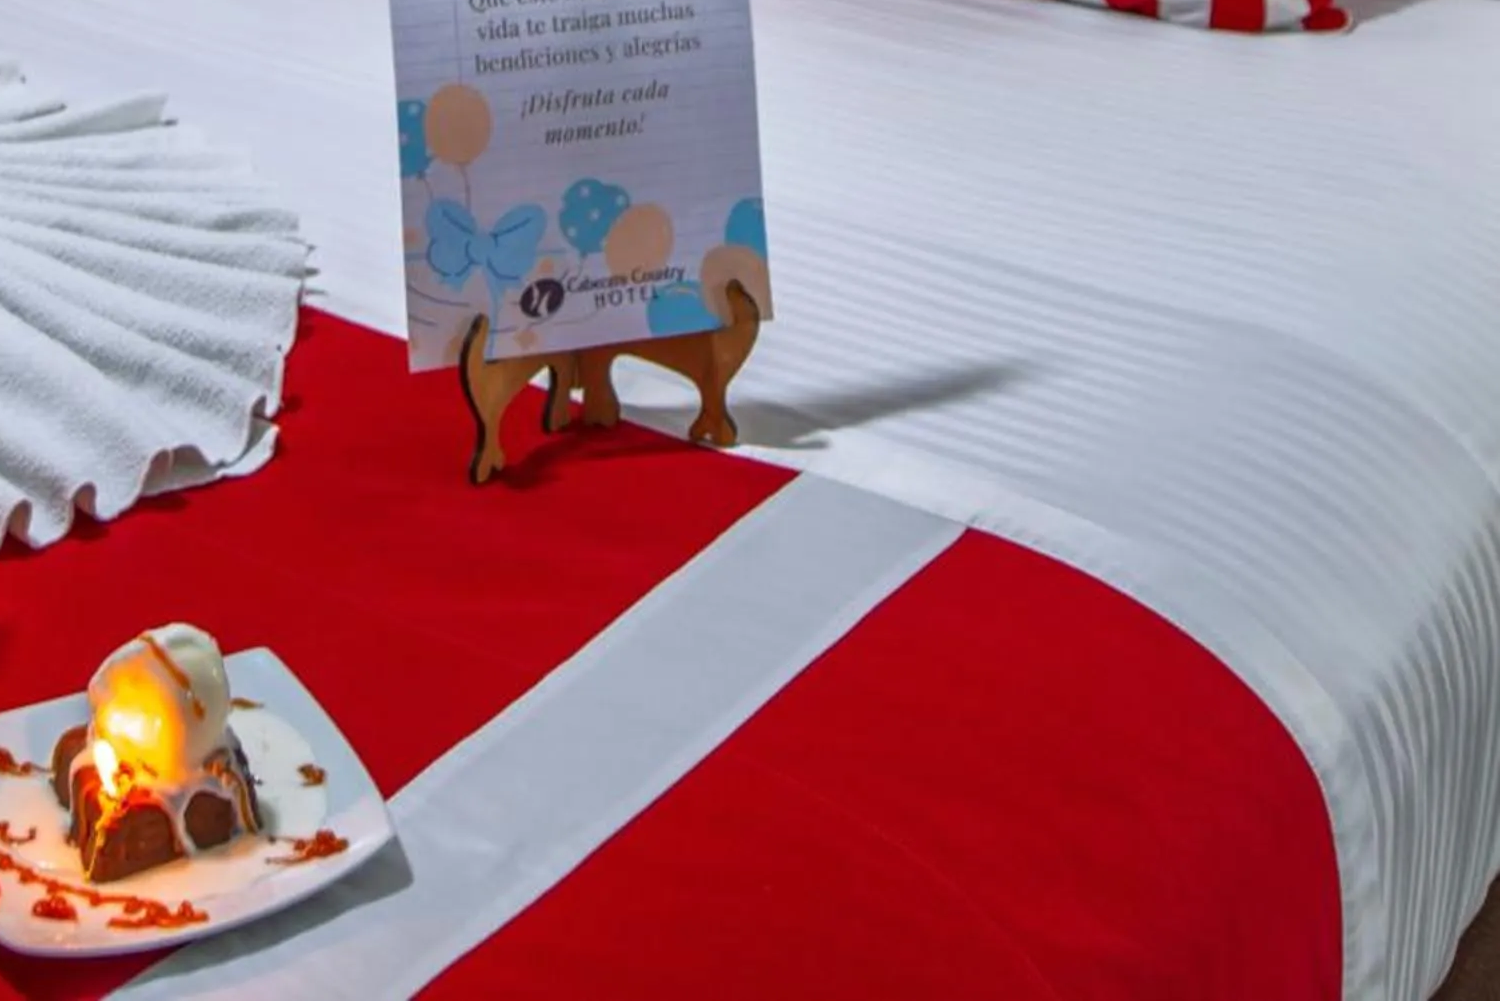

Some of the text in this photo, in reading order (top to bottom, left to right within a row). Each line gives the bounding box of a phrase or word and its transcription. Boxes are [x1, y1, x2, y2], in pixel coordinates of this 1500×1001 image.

[476, 0, 695, 42] vida te traiga muchas
[474, 31, 703, 76] bendiciones y alegrías
[520, 78, 671, 121] ¡Disfruta cada
[543, 112, 646, 146] momento!
[593, 283, 660, 310] HOTEL
